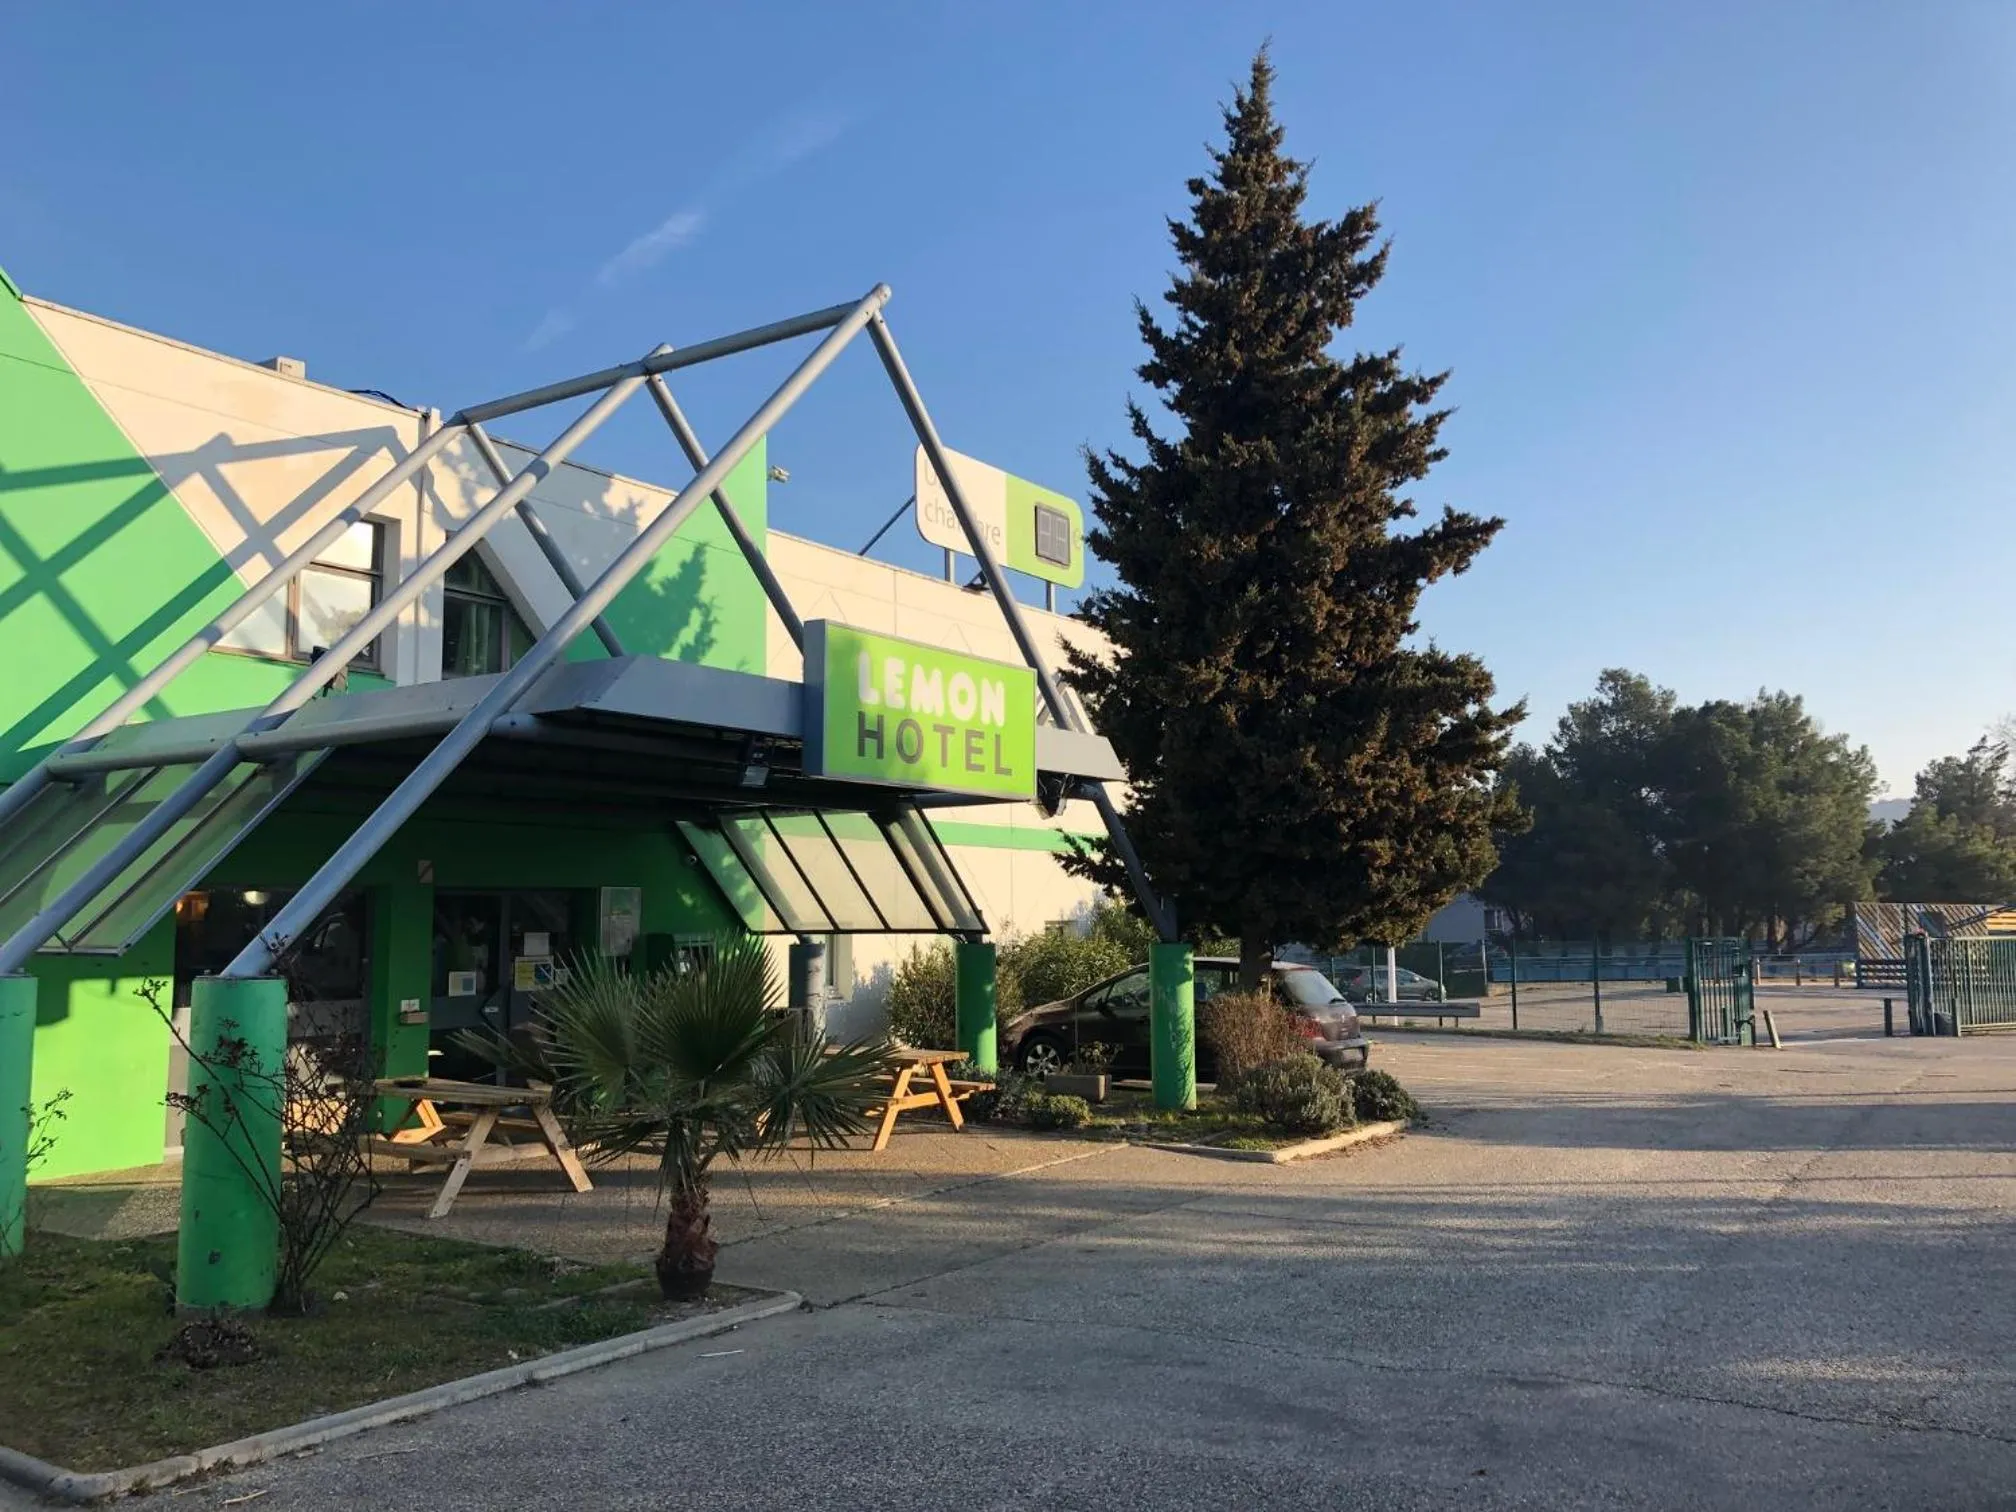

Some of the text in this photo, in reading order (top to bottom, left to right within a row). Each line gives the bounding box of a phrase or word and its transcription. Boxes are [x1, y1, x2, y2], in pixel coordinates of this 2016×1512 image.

[924, 498, 1001, 546] chare
[858, 651, 1005, 727] LEMON
[857, 711, 1013, 776] HOTEL
